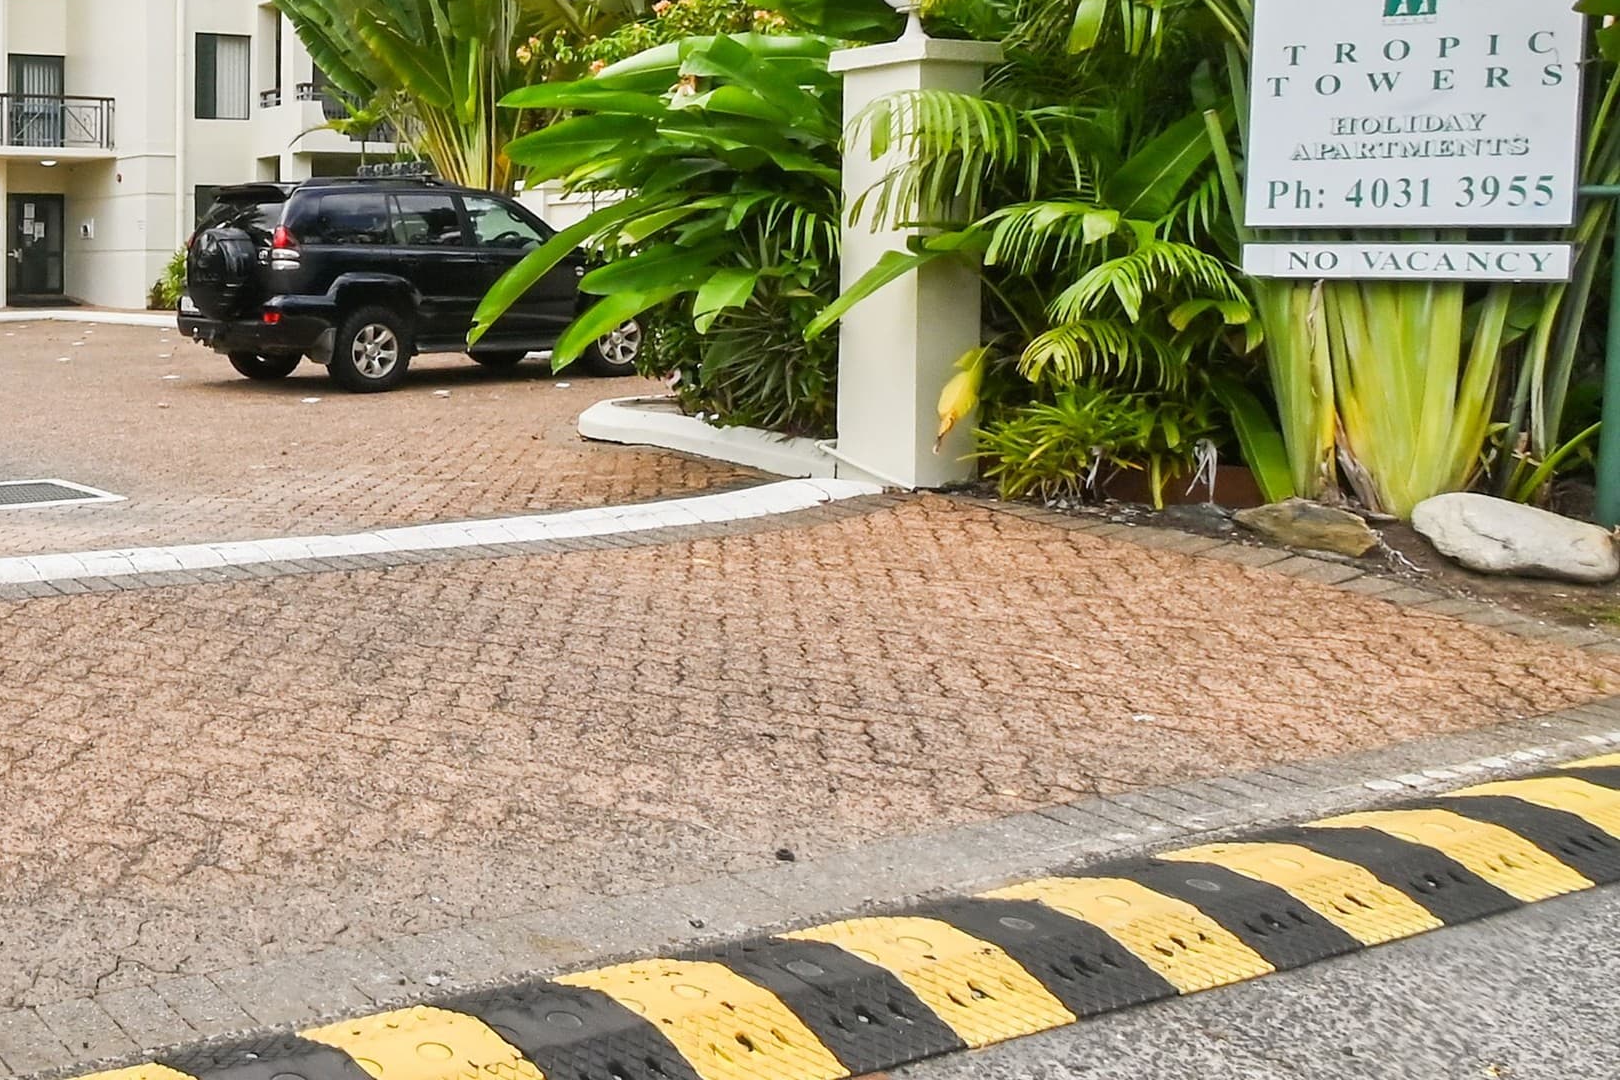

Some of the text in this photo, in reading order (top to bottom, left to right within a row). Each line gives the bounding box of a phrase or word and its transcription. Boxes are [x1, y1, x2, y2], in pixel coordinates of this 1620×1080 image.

[1282, 30, 1556, 67] TROPIC
[1266, 63, 1563, 98] TOWERS
[1330, 112, 1487, 136] HOLIDAY
[1290, 135, 1531, 162] APARTMENTS
[1267, 174, 1556, 210] Ph: 4031 3955
[1287, 251, 1555, 273] NO VACANCY
